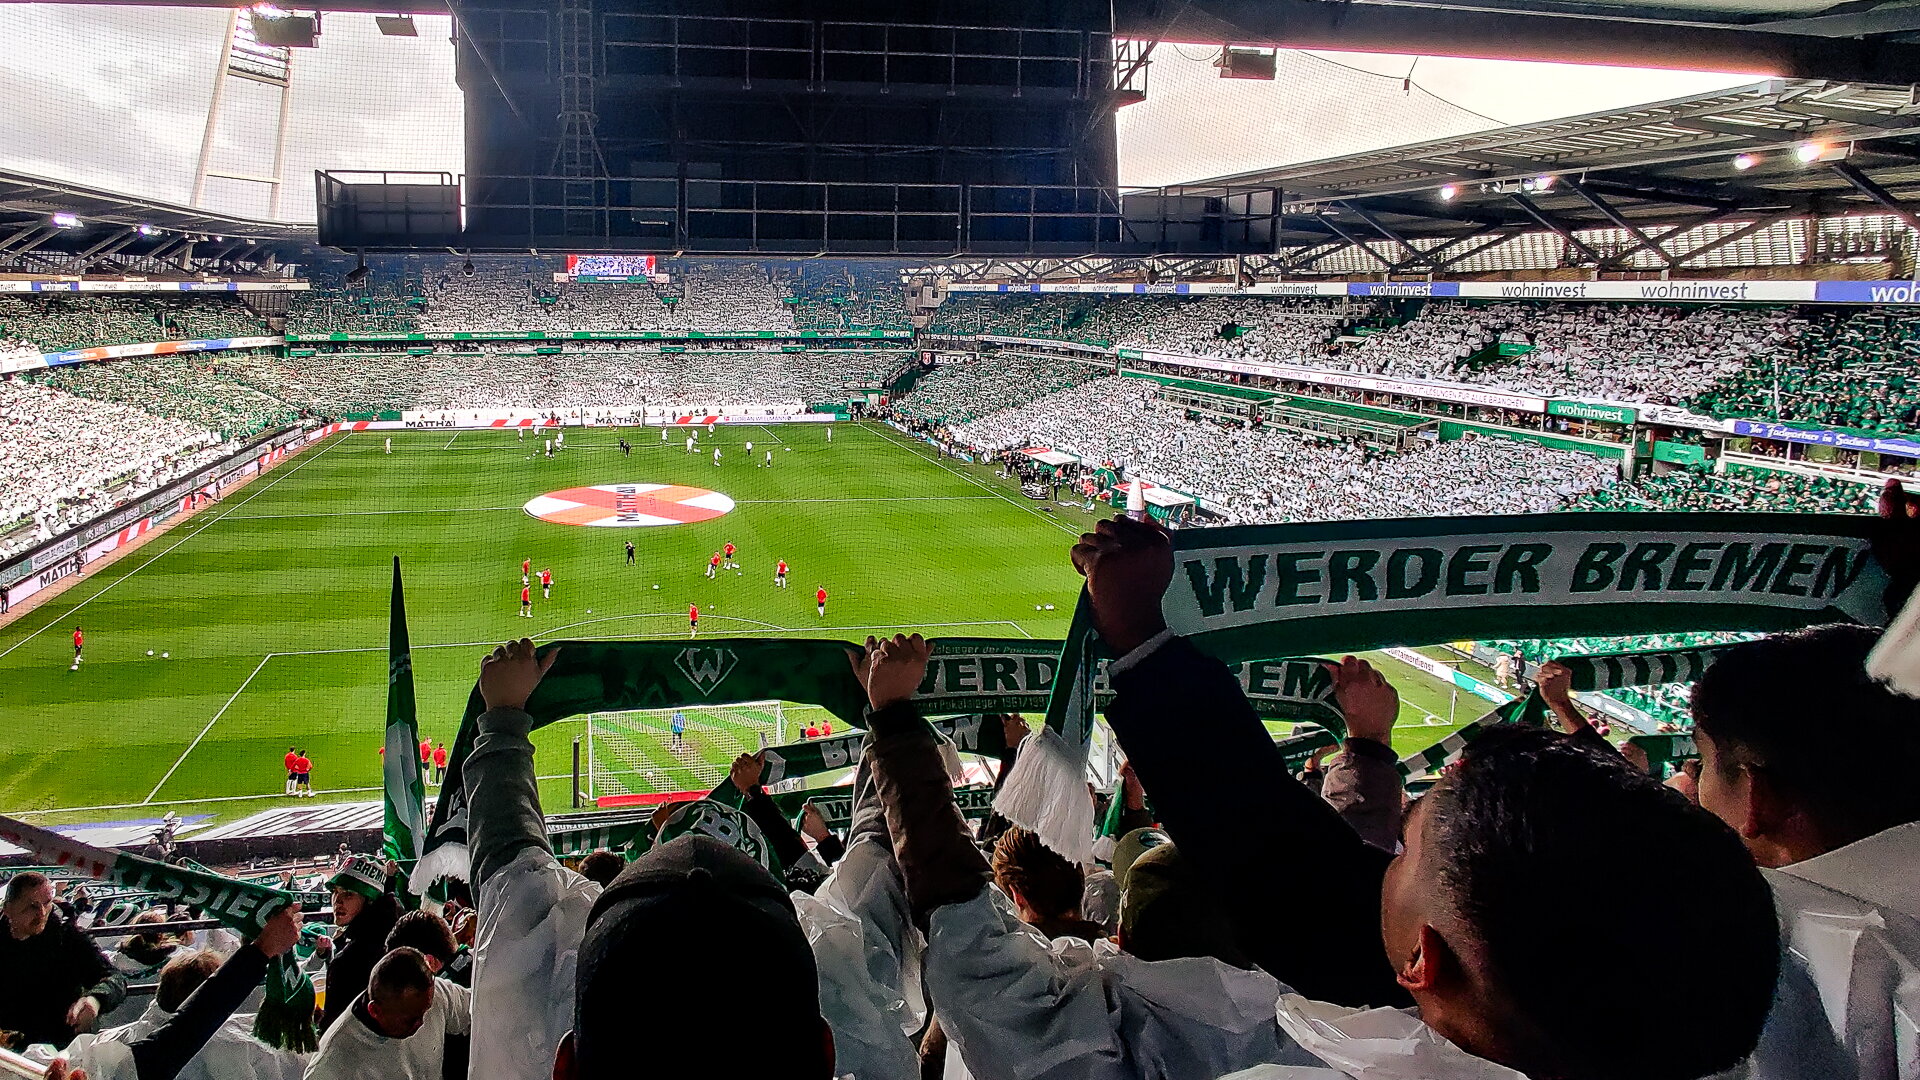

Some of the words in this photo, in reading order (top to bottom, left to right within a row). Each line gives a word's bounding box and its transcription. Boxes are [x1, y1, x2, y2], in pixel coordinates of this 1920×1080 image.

[1271, 284, 1317, 295] wohninvest
[1370, 283, 1432, 296] wohninvest
[1501, 283, 1586, 298] wohninvest
[1641, 282, 1748, 299] wohninvest
[298, 333, 330, 341] HOYER
[1471, 393, 1487, 403] ALLE
[1489, 395, 1525, 407] BRANCHEN
[1557, 403, 1623, 422] wohninvest
[1185, 543, 1552, 617] WERDER
[1571, 541, 1866, 599] BREMEN
[939, 699, 997, 710] Pokalsieger
